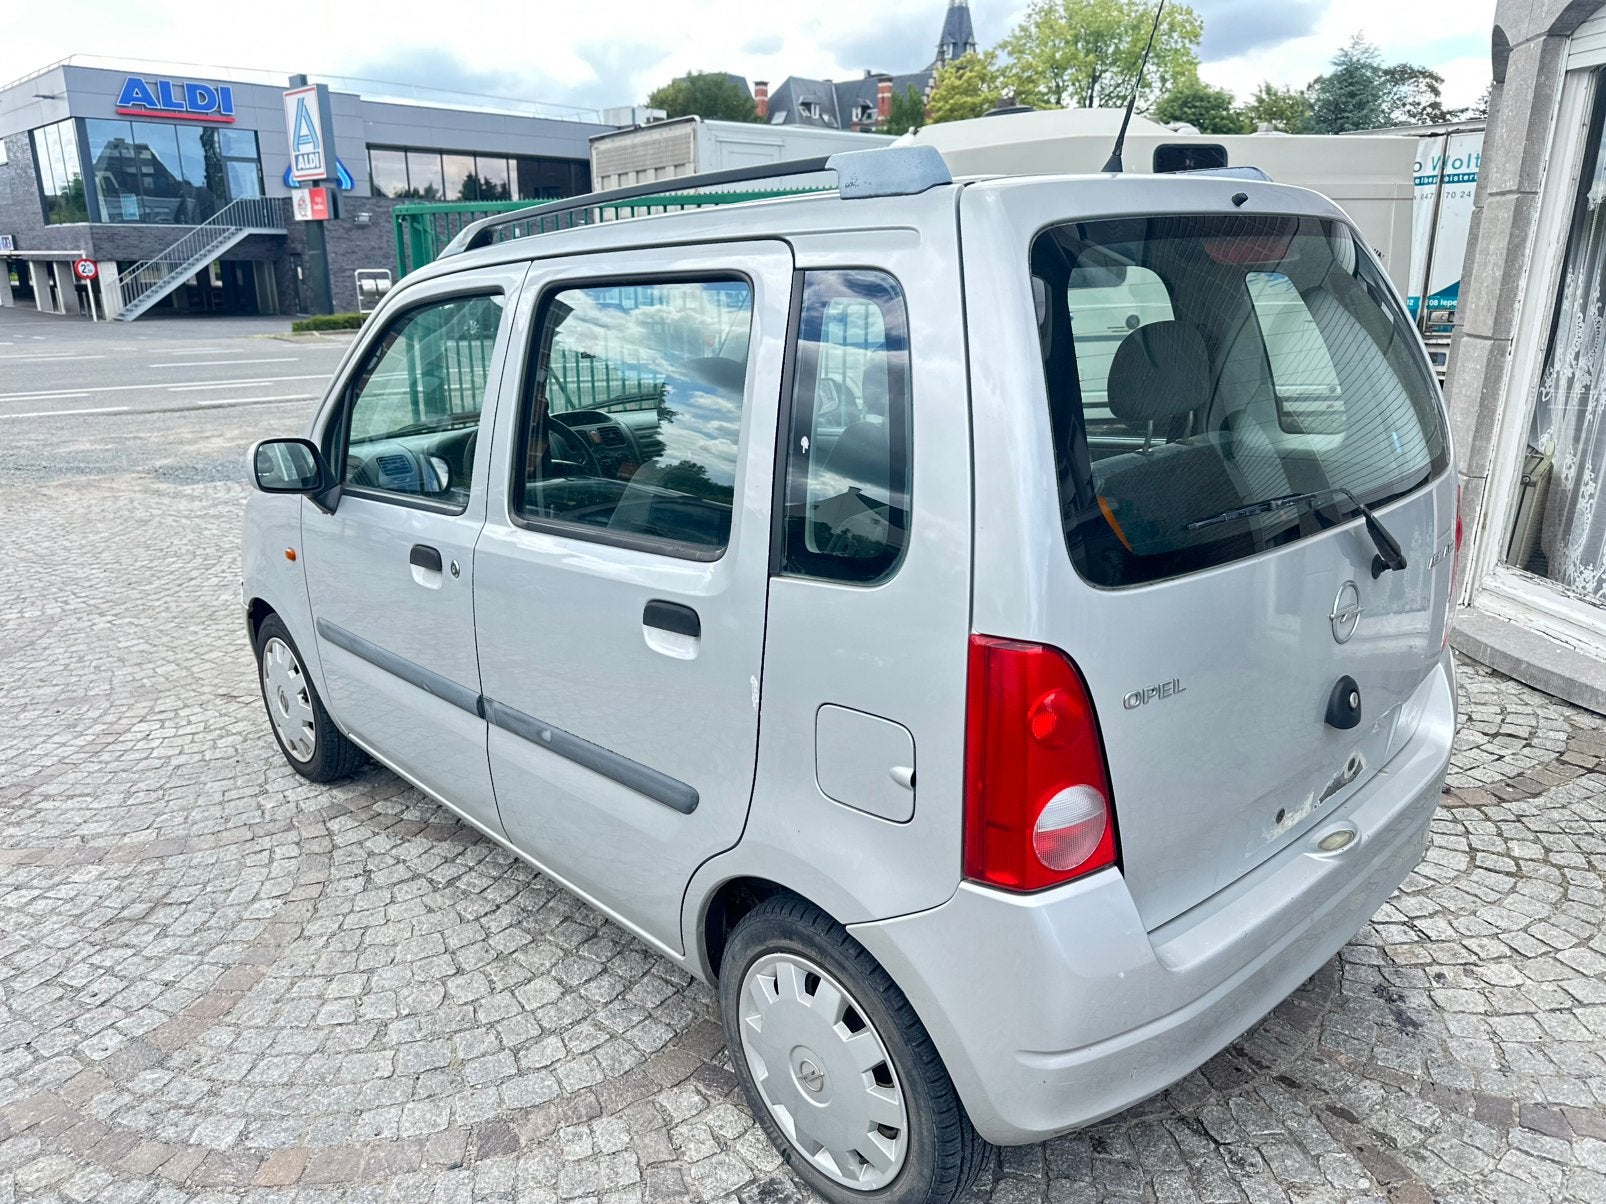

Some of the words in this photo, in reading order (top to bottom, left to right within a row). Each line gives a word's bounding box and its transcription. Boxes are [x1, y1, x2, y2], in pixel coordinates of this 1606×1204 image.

[117, 76, 235, 115] ALDI
[297, 154, 319, 169] ALDI
[1445, 191, 1457, 199] 70
[1459, 190, 1472, 199] 24
[1123, 678, 1187, 710] OPEL
